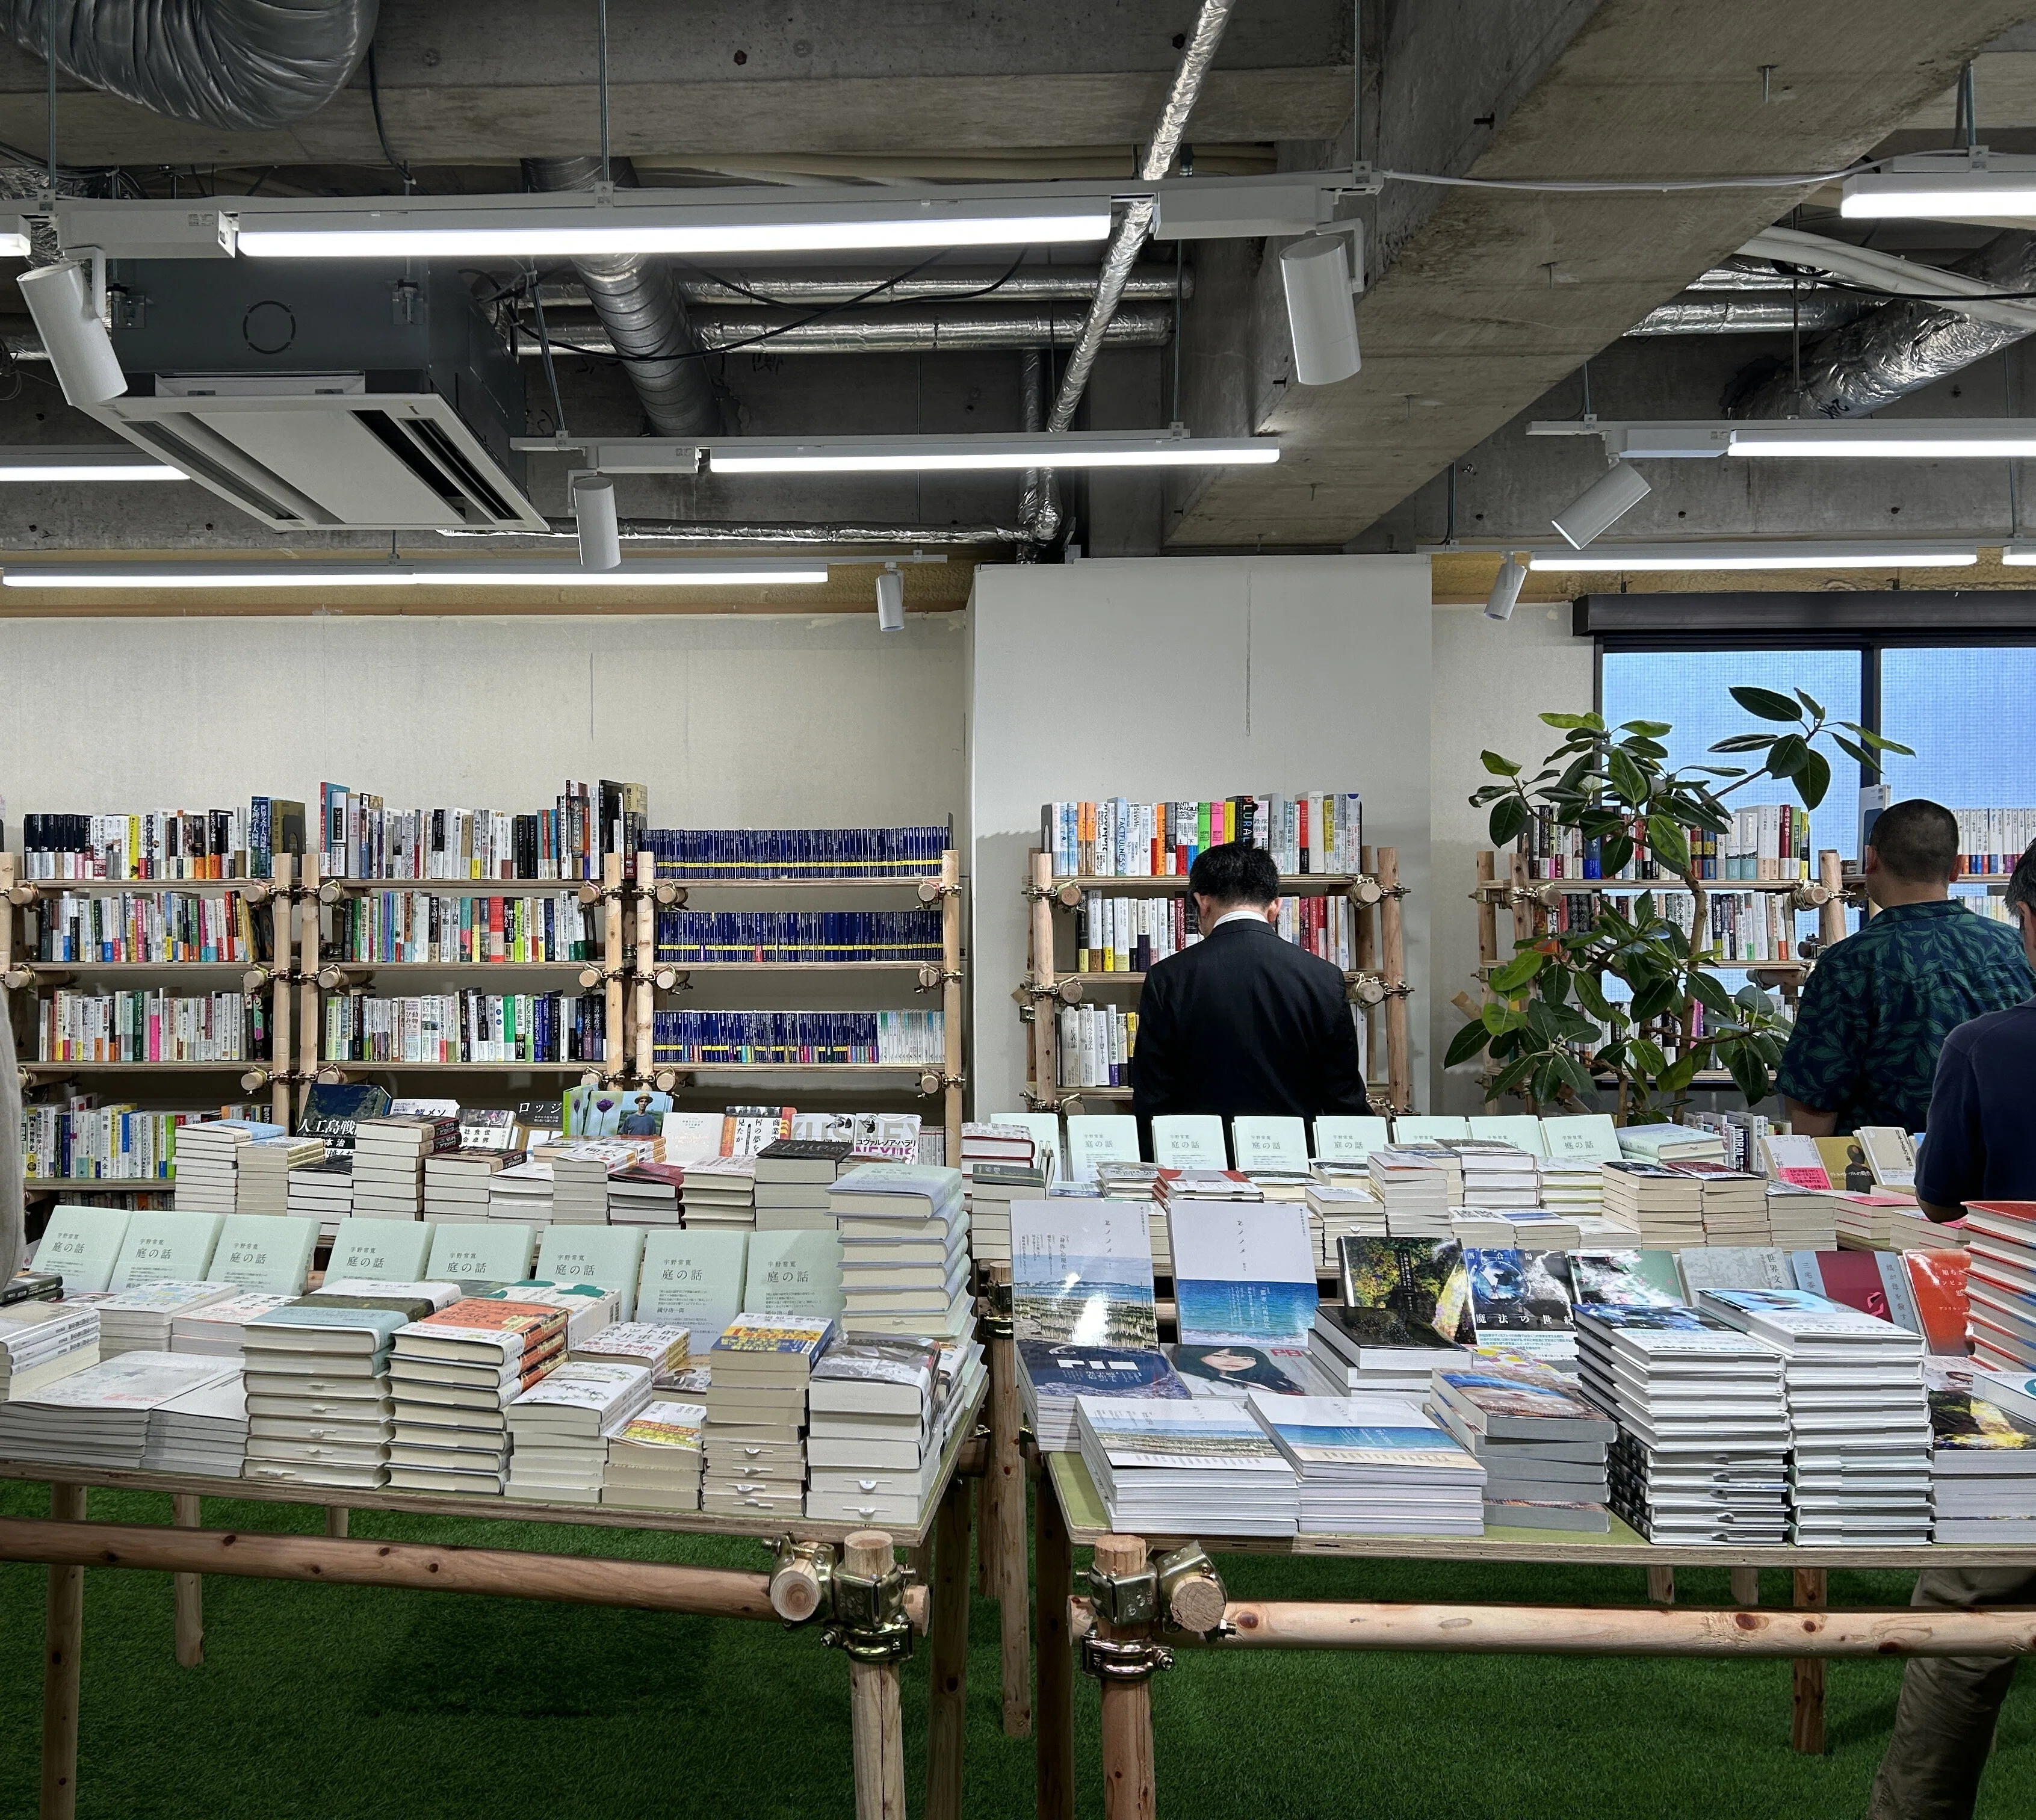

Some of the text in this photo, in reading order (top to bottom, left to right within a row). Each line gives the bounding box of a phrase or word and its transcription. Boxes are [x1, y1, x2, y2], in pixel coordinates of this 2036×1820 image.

[735, 1118, 745, 1143] 見たか
[753, 1118, 763, 1152] 何の夢を
[52, 1242, 85, 1254] 庭の話
[135, 1248, 172, 1259] 庭の話
[229, 1252, 267, 1264] 庭の話
[347, 1256, 385, 1268] 庭の話
[447, 1261, 486, 1274] 庭の話
[554, 1264, 595, 1277] 庭の話
[661, 1269, 702, 1281] 庭の話
[767, 1271, 809, 1283] 庭の話
